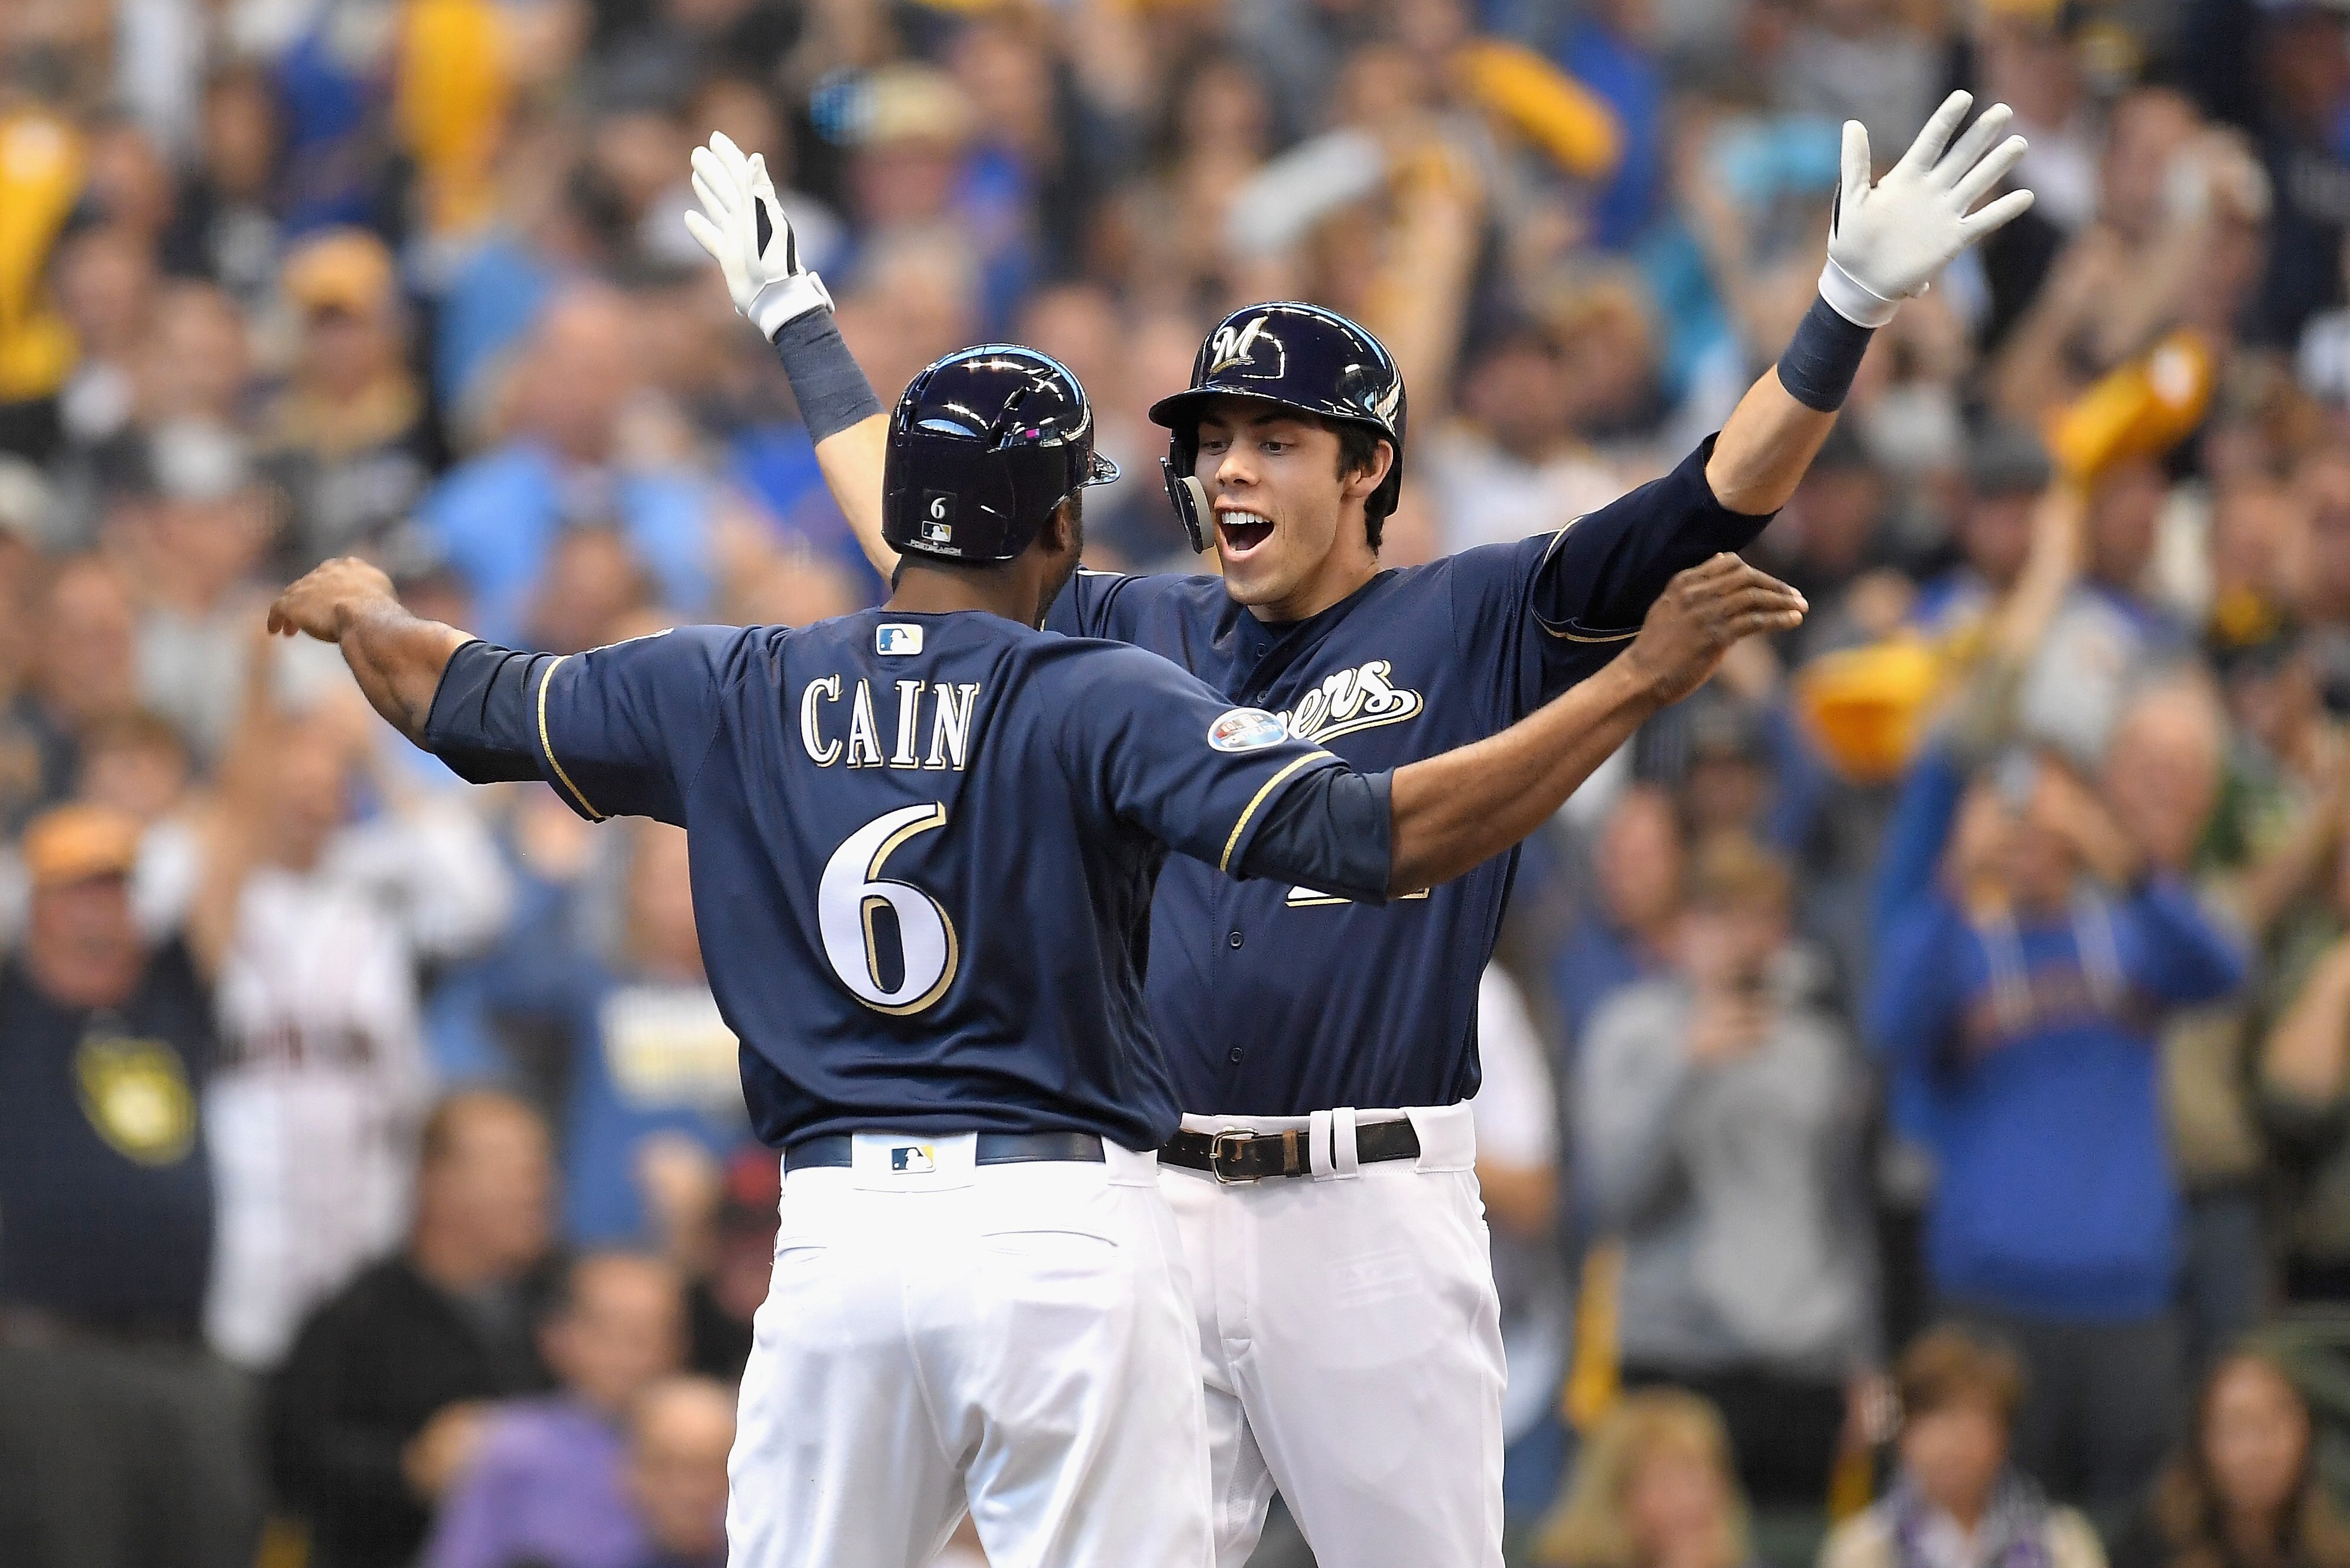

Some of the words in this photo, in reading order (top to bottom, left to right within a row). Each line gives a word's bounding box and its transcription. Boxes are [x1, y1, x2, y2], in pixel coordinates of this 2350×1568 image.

[1212, 315, 1268, 374] M
[930, 497, 946, 519] 6
[800, 674, 981, 771] CAIN
[1276, 659, 1424, 745] ers
[818, 800, 959, 1015] 6
